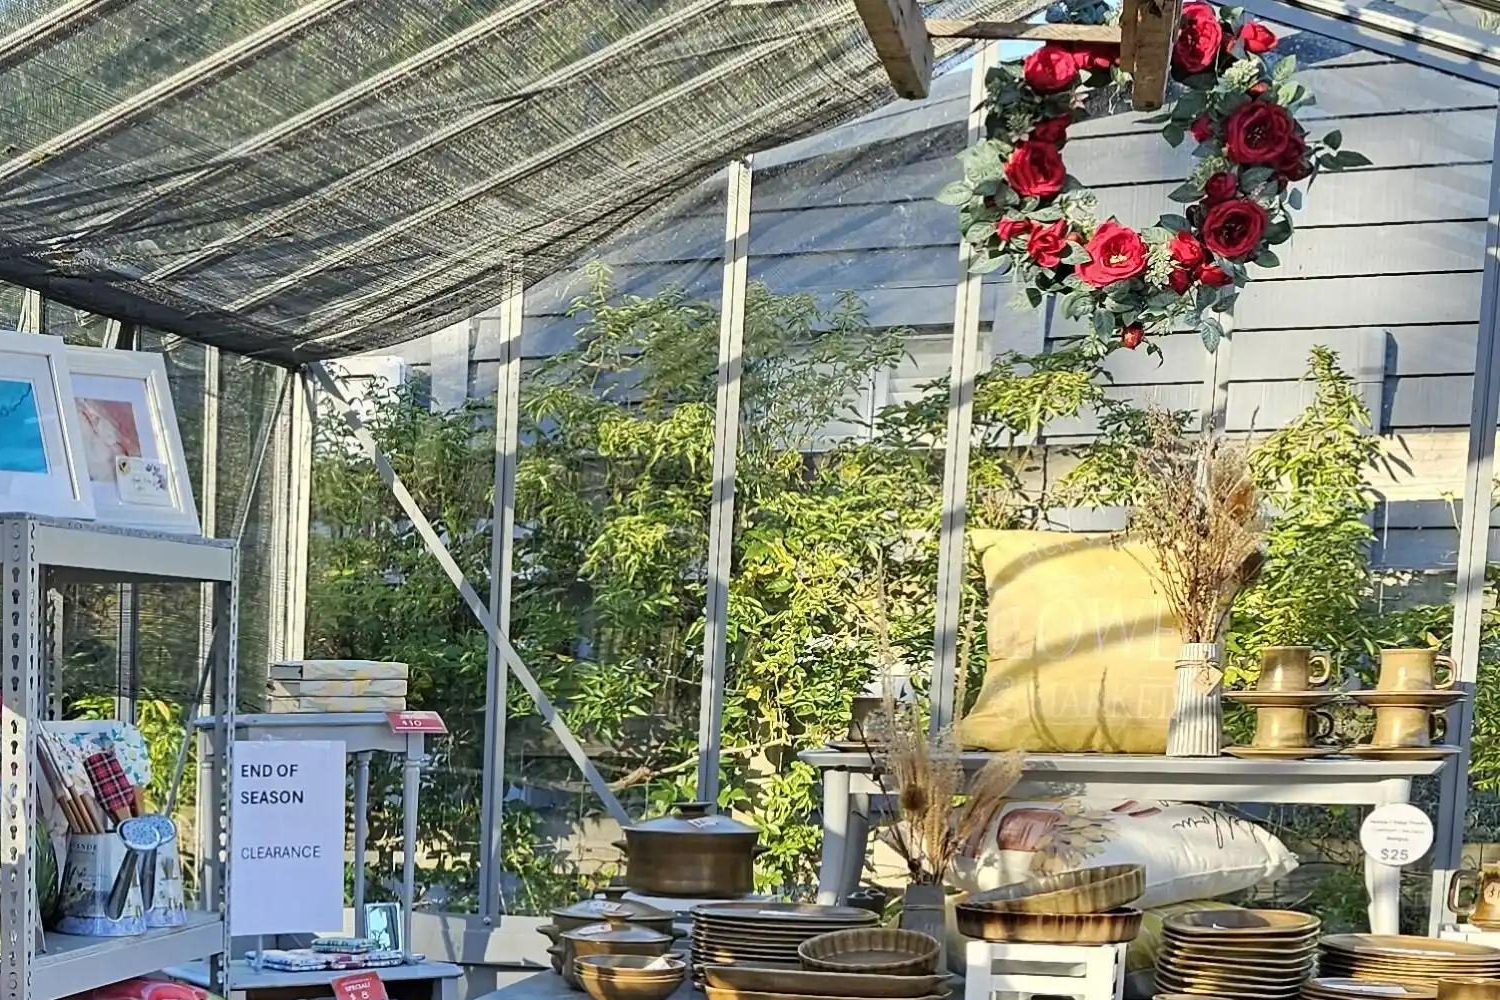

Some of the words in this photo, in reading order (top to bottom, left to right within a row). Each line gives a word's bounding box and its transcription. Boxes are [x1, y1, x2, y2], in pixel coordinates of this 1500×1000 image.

[240, 764, 273, 778] END
[276, 764, 299, 778] OF
[240, 790, 304, 804] SEASON
[240, 845, 321, 860] CLEARANCE
[1380, 848, 1409, 861] $25
